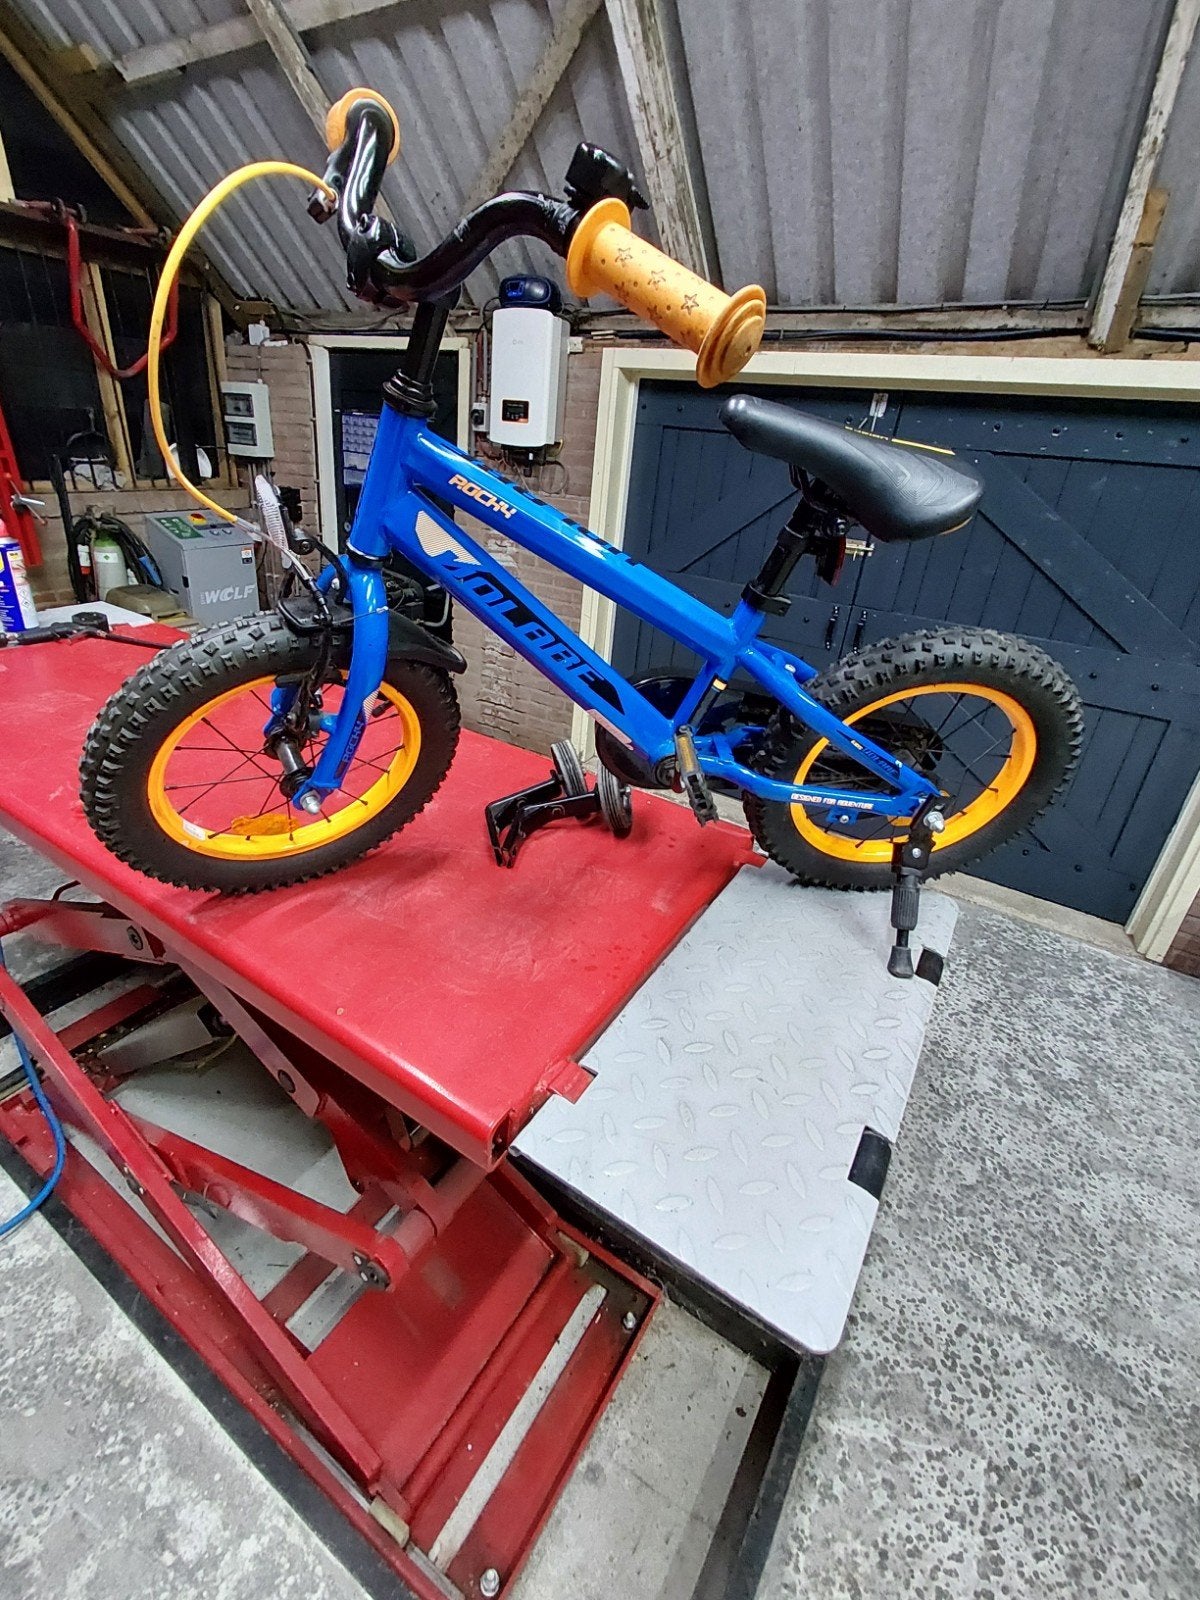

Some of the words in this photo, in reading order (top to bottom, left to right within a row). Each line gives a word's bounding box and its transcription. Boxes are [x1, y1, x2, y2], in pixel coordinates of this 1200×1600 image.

[448, 474, 518, 519] ROCKY
[790, 793, 822, 804] DESIGNED
[822, 797, 836, 806] FOR
